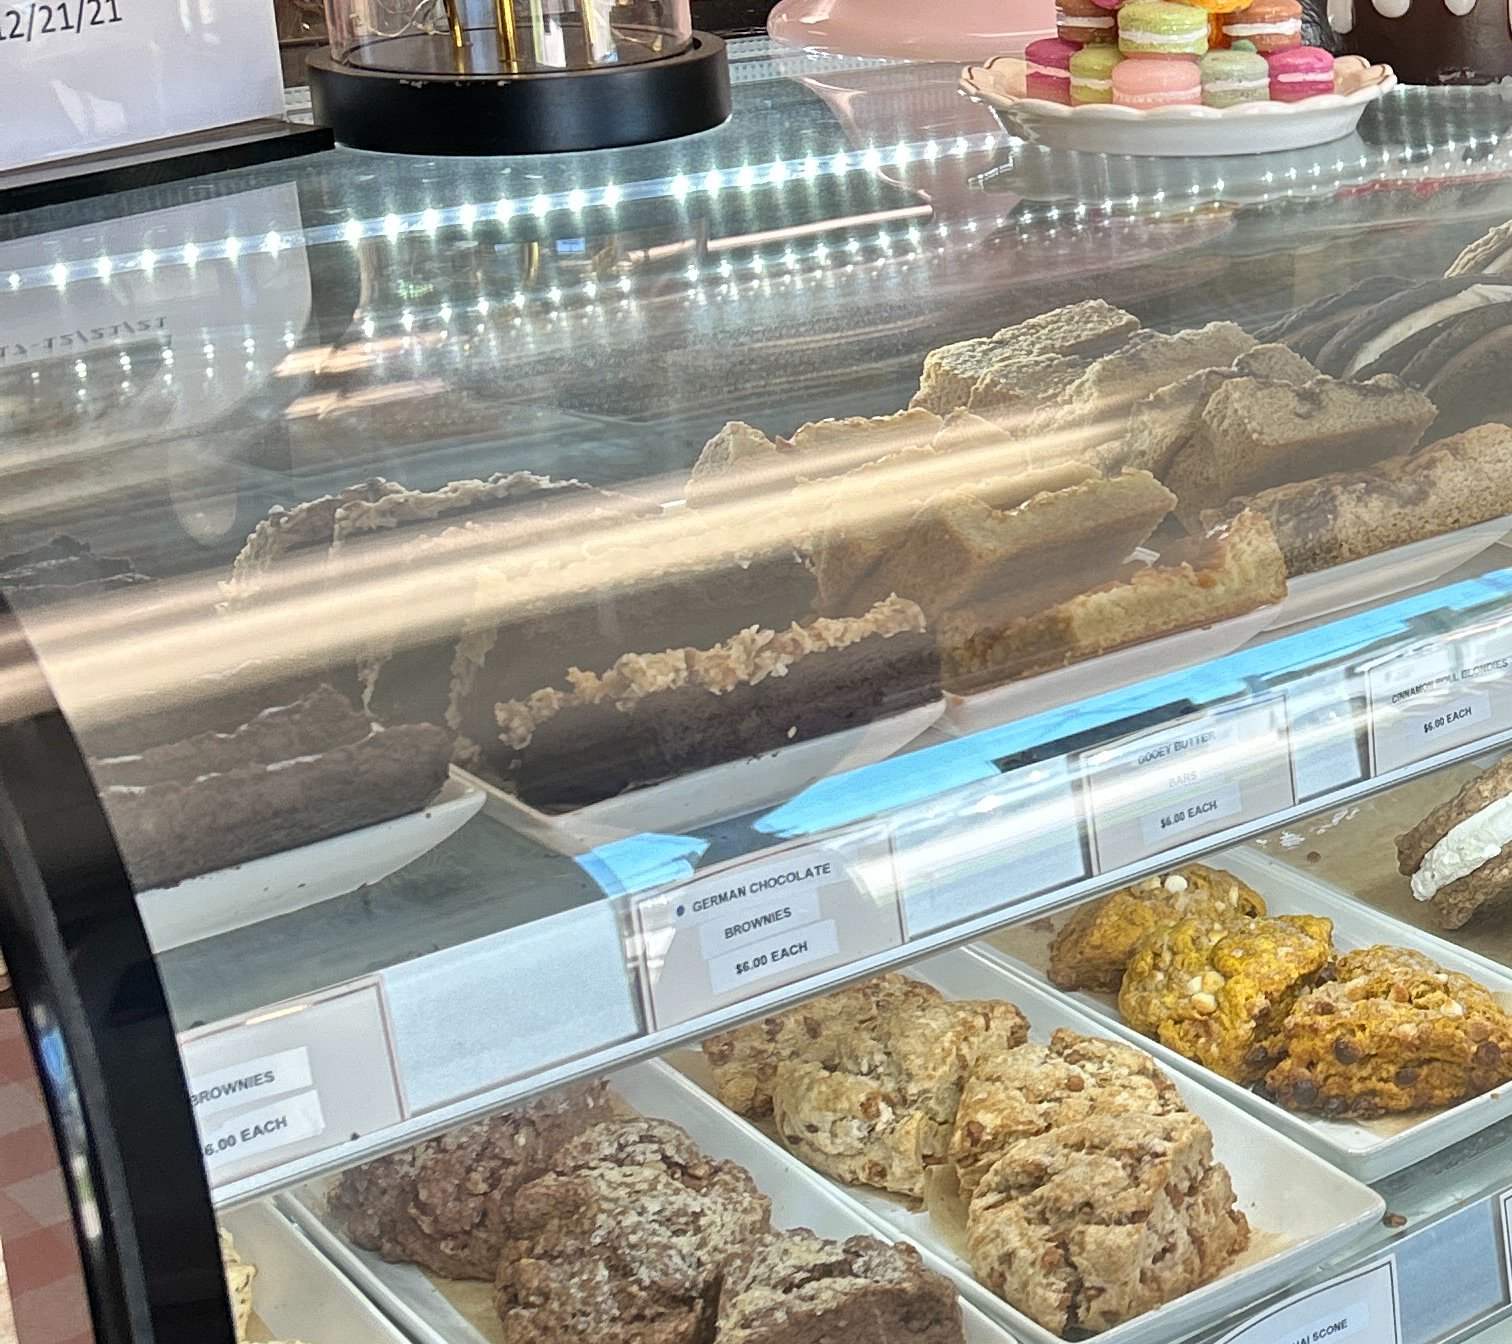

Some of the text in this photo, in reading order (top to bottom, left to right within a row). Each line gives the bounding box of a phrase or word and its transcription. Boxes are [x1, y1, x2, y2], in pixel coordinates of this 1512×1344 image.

[1461, 658, 1509, 680] BLONDIES
[1424, 707, 1472, 733] $6.00 EACH
[1138, 731, 1216, 765] GOOEY BUTTER
[1168, 771, 1197, 787] BARS
[1161, 800, 1217, 828] $6.00 EACH
[692, 863, 831, 912] GERMAN CHOCOLATE
[725, 907, 792, 939] BROWNIES
[736, 941, 808, 975] $6.00 EACH
[191, 1071, 275, 1106] BROWNIES
[201, 1116, 287, 1156] 6.00 EACH
[1312, 1318, 1348, 1342] SCONE
